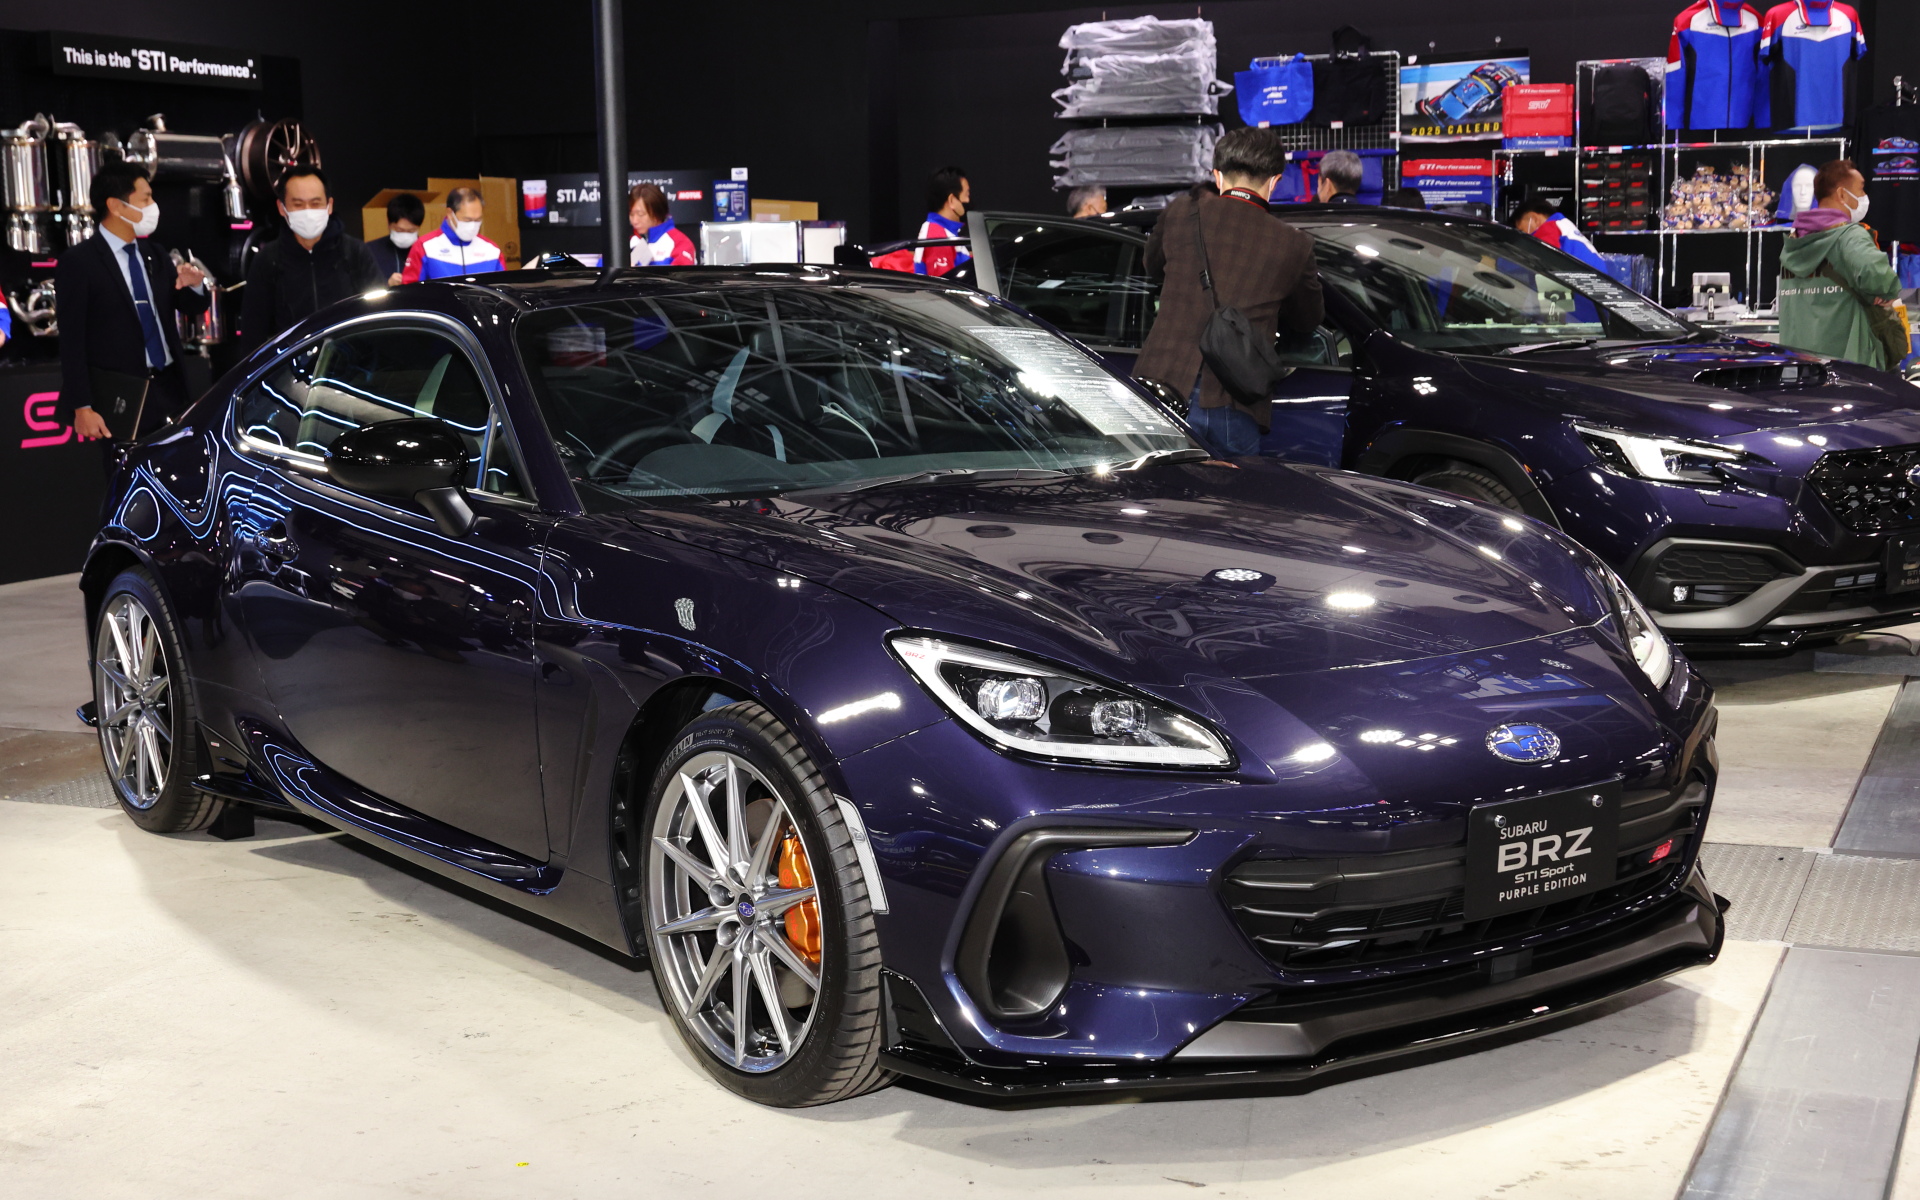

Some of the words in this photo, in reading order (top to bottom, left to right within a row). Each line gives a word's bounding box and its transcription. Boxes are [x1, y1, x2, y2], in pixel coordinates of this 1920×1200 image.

[63, 46, 93, 65] This
[95, 50, 106, 66] is
[108, 52, 131, 68] the
[1411, 126, 1441, 136] 2025
[1447, 122, 1500, 135] CALEND
[1419, 163, 1435, 171] STI
[556, 189, 577, 203] STI
[667, 192, 677, 202] by
[904, 650, 926, 660] BRZ
[1500, 820, 1547, 839] SUBARU
[1497, 826, 1593, 873] BRZ
[1514, 870, 1538, 884] STI
[1540, 862, 1574, 878] Sport
[1499, 884, 1539, 901] PURPLE
[1544, 873, 1587, 892] EDITION
